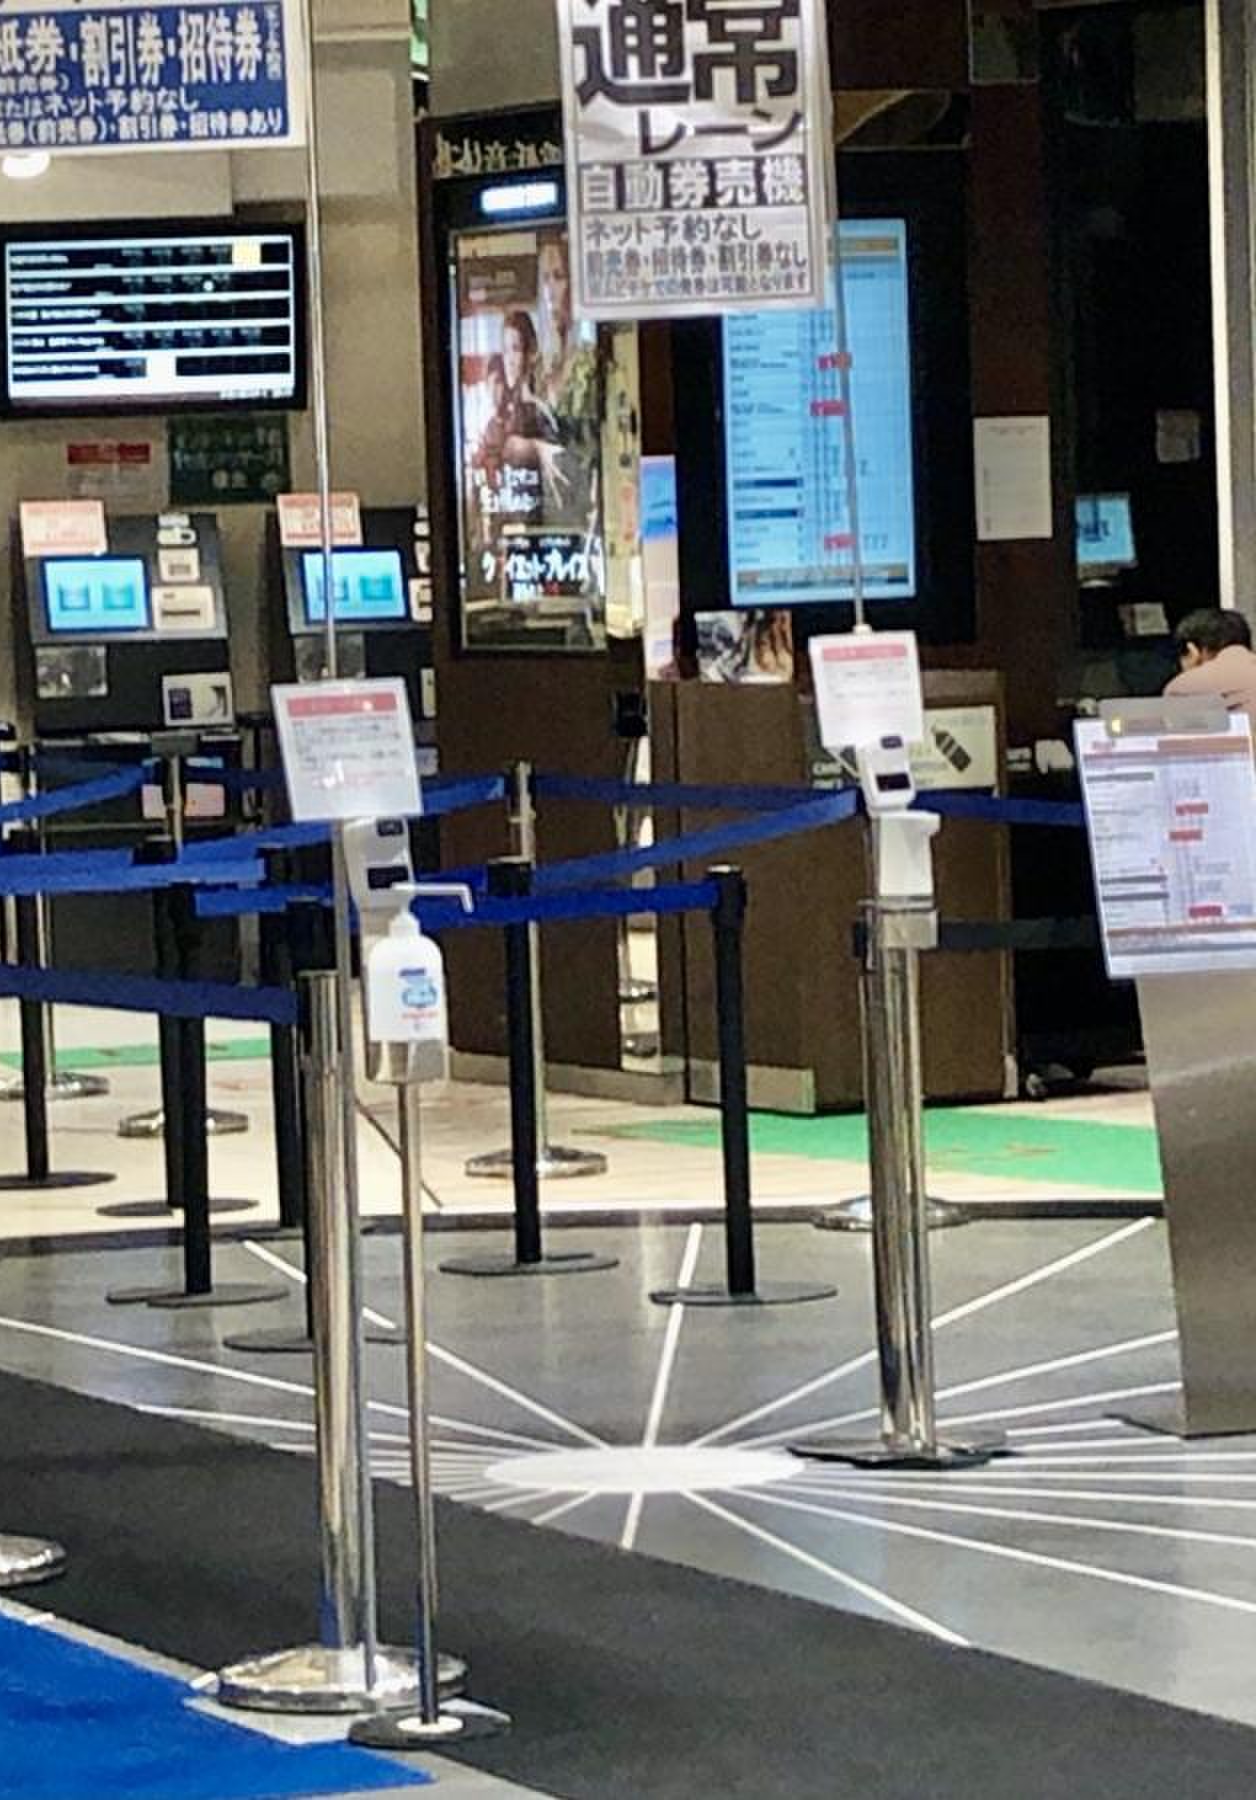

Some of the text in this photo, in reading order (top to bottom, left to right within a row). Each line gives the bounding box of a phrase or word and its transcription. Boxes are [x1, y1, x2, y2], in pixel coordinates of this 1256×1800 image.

[570, 0, 801, 106] 通常
[637, 108, 804, 155] レーン
[583, 156, 805, 212] 自動券売機
[585, 213, 763, 247] ネット予約なし
